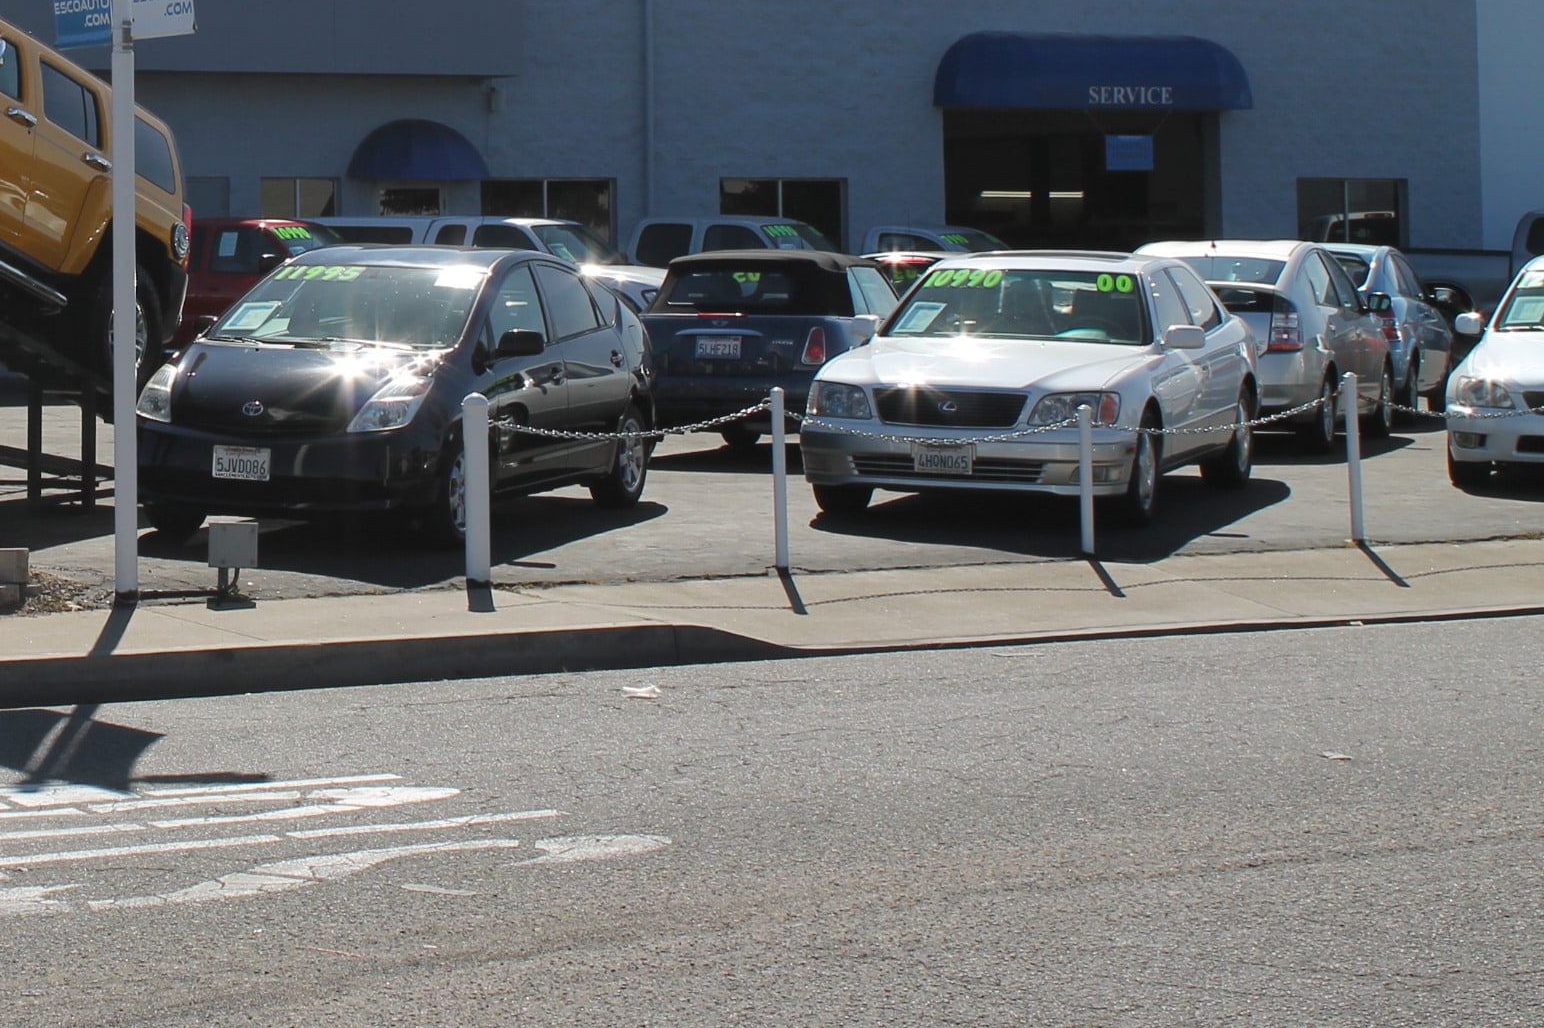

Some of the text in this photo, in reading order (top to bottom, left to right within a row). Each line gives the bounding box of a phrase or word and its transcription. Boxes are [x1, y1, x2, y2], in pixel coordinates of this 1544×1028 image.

[164, 1, 192, 16] .COM
[84, 13, 110, 27] .COM
[1089, 86, 1173, 104] SERVICE
[274, 265, 367, 282] 11995
[924, 270, 1003, 288] 10990
[1096, 274, 1134, 293] 00
[216, 457, 266, 475] 5JVD086
